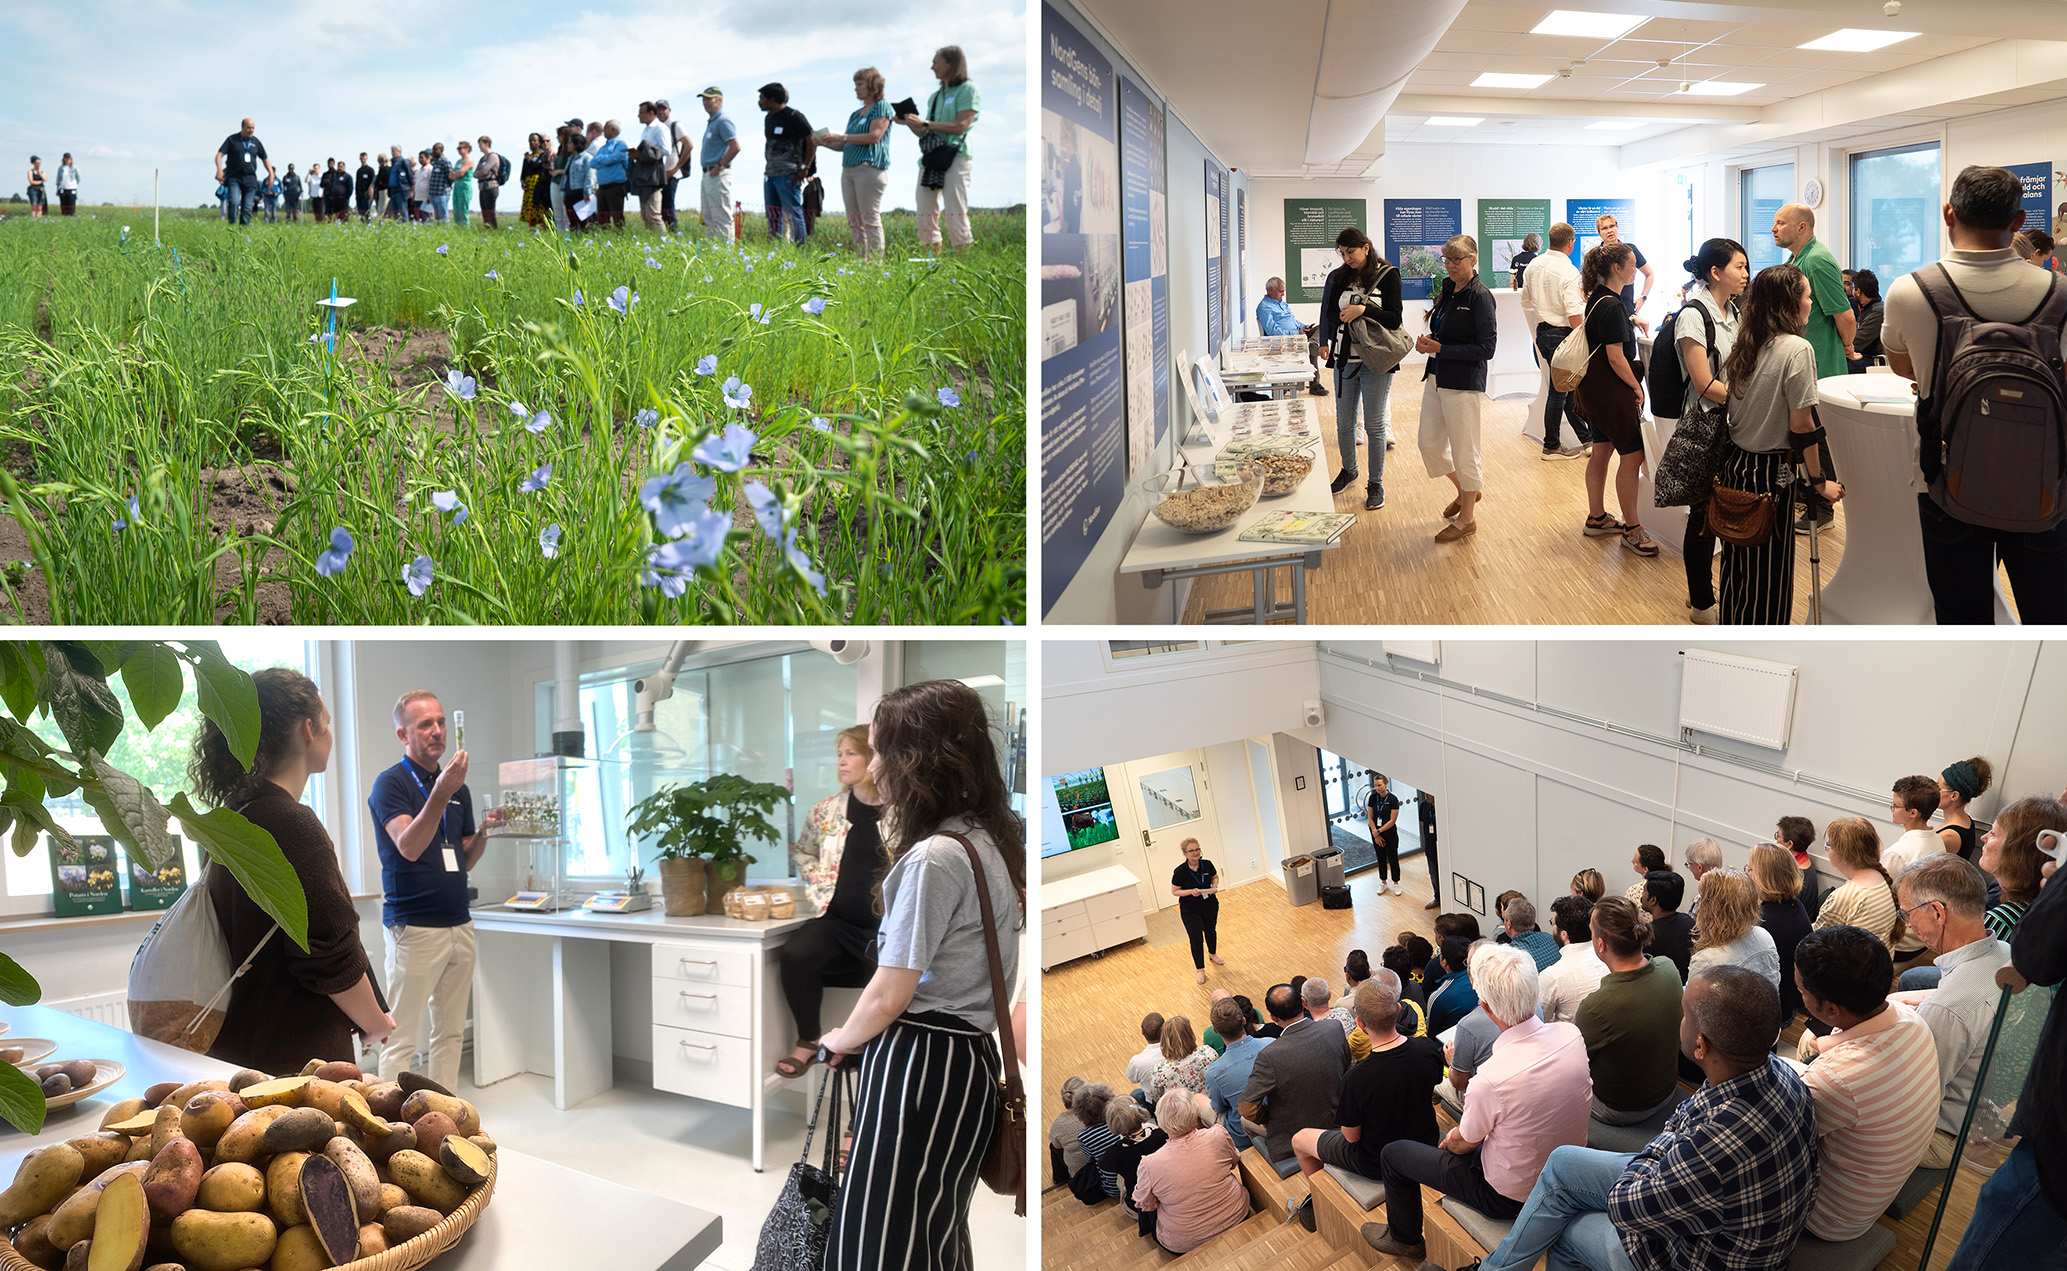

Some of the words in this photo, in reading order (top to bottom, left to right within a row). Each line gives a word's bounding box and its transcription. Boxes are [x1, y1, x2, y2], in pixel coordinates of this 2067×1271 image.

[1050, 33, 1088, 81] NordGens
[1051, 69, 1082, 106] samling
[2020, 175, 2047, 184] främjar
